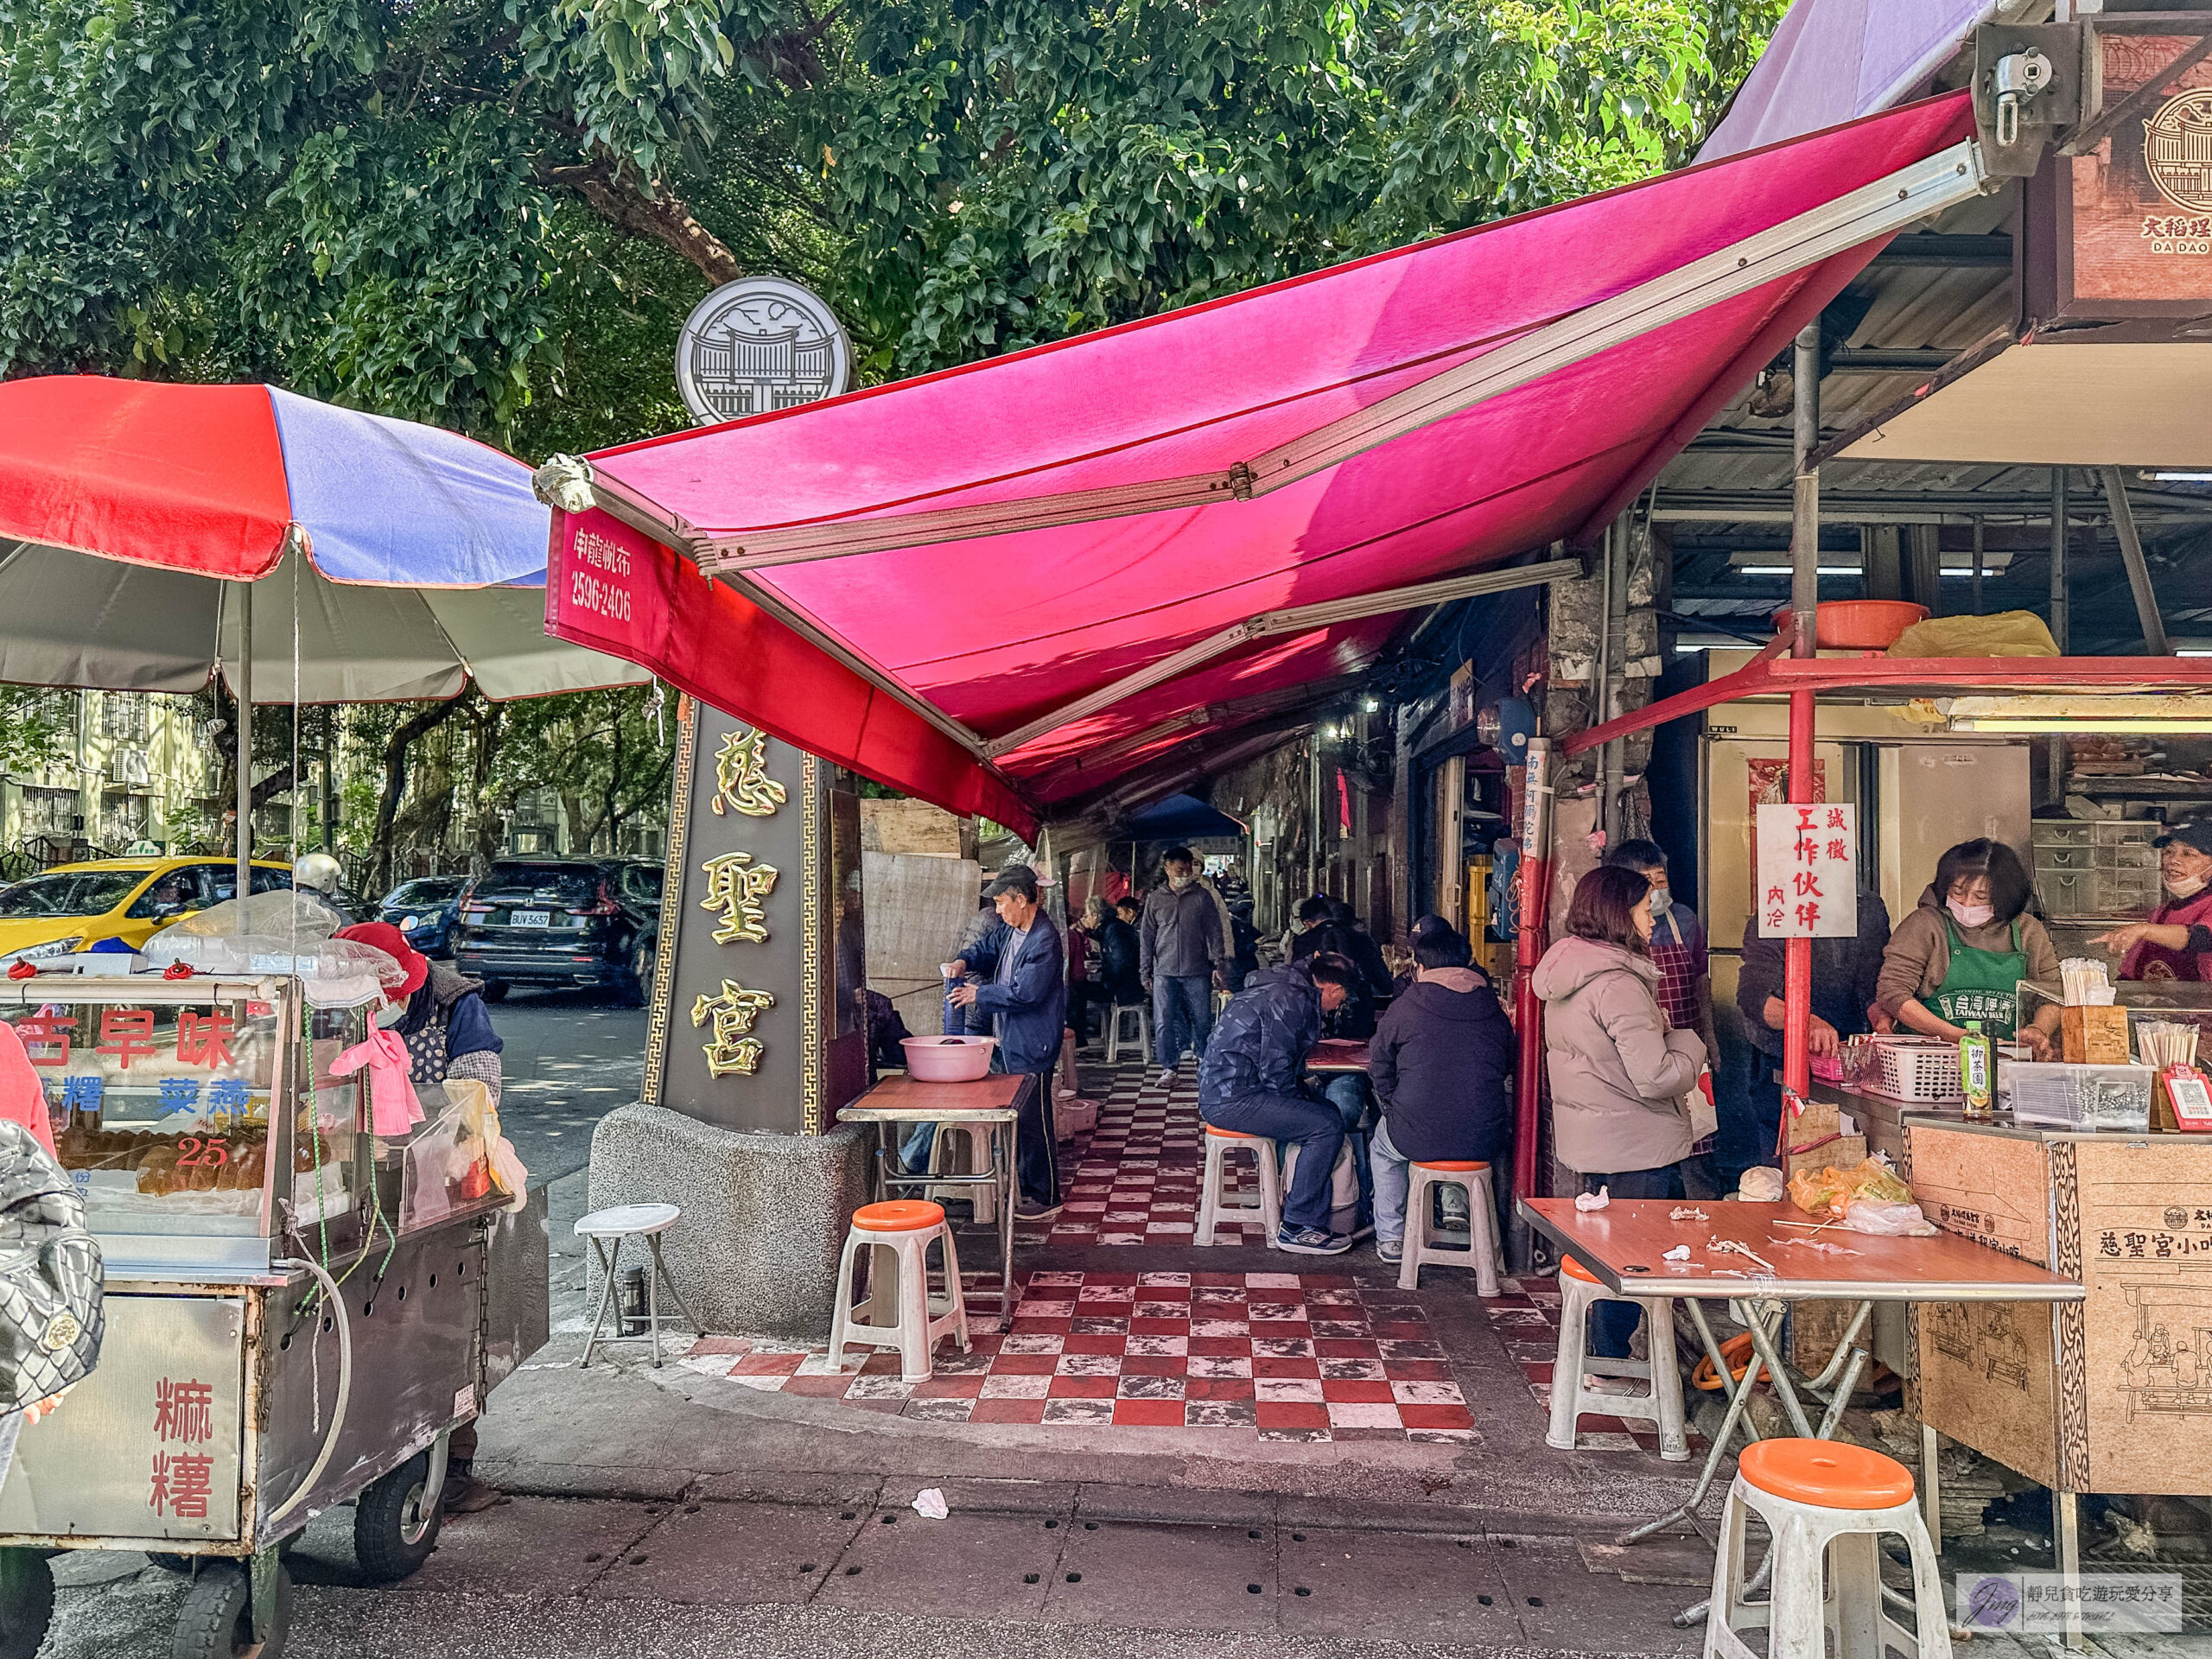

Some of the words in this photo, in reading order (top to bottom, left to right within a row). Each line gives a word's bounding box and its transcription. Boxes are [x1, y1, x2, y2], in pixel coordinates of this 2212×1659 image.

[2153, 242, 2172, 252] DA
[2178, 243, 2208, 252] DAO
[571, 569, 632, 623] 2596-2406
[1825, 807, 1850, 862] 誠徵
[1792, 809, 1825, 932] 工作伙伴
[690, 725, 787, 1082] 慈聖宮
[1953, 1008, 1988, 1019] TAIWAN
[18, 1009, 237, 1071] 古早味
[1971, 1048, 1985, 1085] 御茶園
[42, 1075, 105, 1112] 糬
[157, 1077, 251, 1115] 菜燕
[175, 1137, 228, 1166] 25
